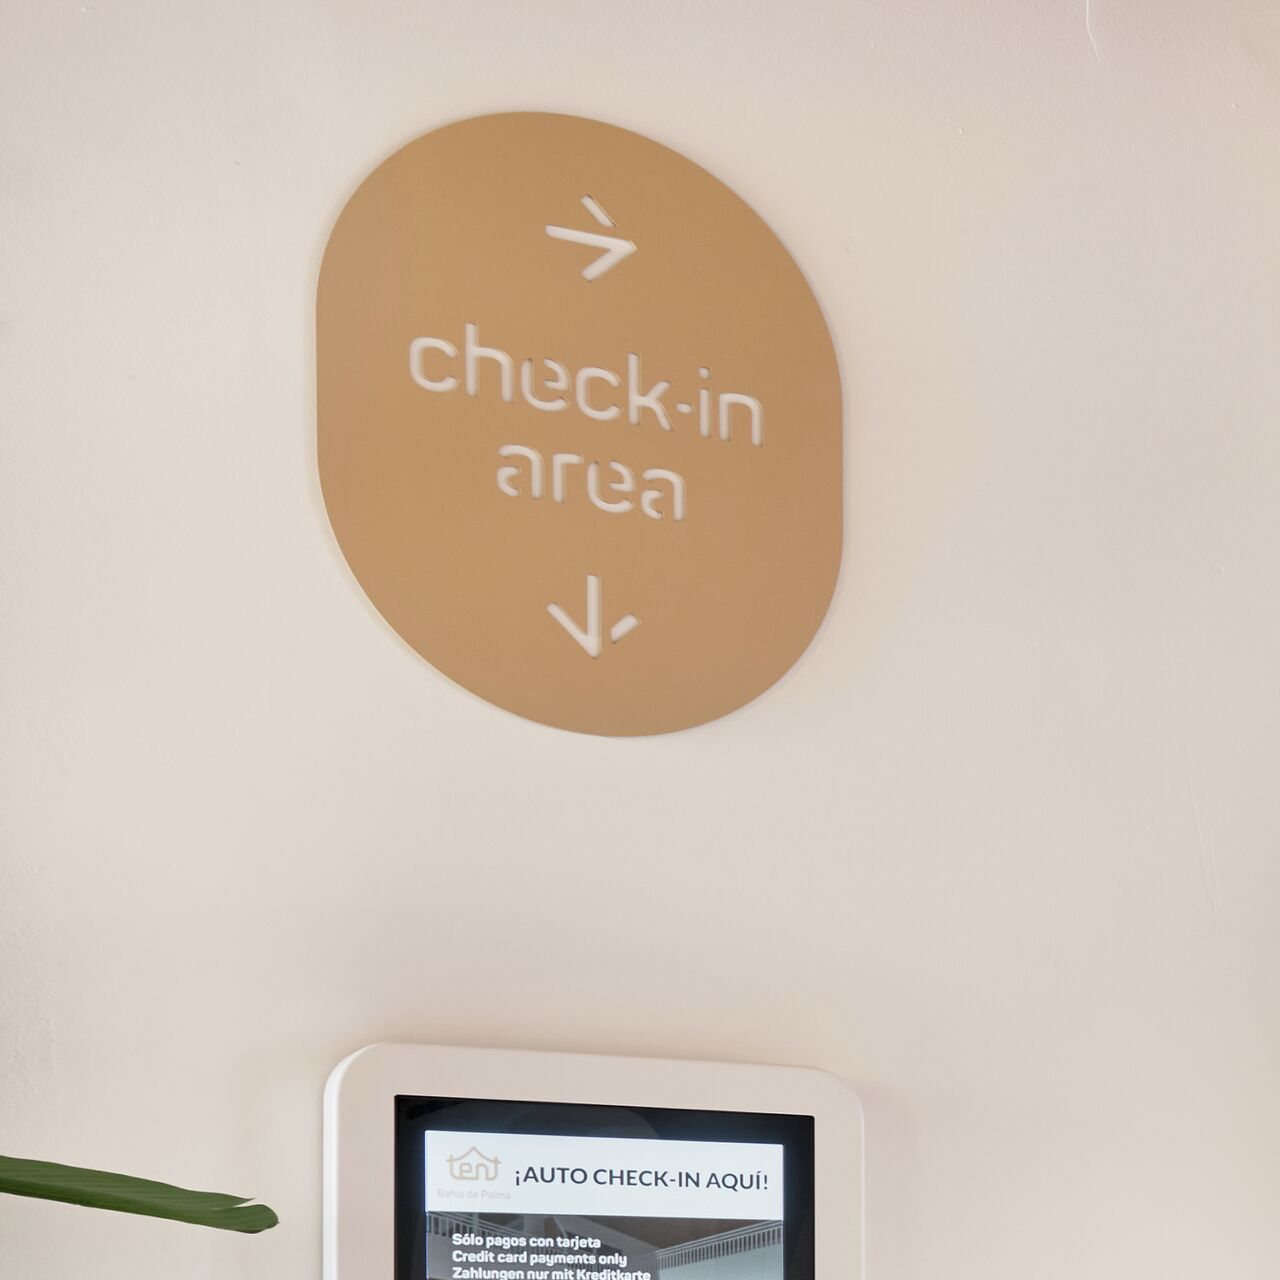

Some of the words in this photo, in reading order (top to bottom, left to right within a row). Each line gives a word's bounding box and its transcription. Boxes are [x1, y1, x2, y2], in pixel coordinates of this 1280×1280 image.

[409, 322, 764, 447] check-in
[496, 444, 686, 522] area
[514, 1166, 588, 1186] ¡AUTO
[593, 1168, 700, 1188] CHECK-IN
[705, 1170, 768, 1192] AQUÍ!
[452, 1233, 484, 1247] Sólo
[485, 1236, 527, 1249] pagos
[529, 1237, 554, 1247] con
[556, 1235, 601, 1250] tarjeta
[452, 1250, 495, 1263] Credit
[497, 1251, 527, 1263] card
[529, 1253, 597, 1266] payments
[598, 1253, 628, 1267] only
[526, 1269, 549, 1279] nur
[551, 1268, 574, 1280] mit
[576, 1269, 651, 1280] Kreditkarte
